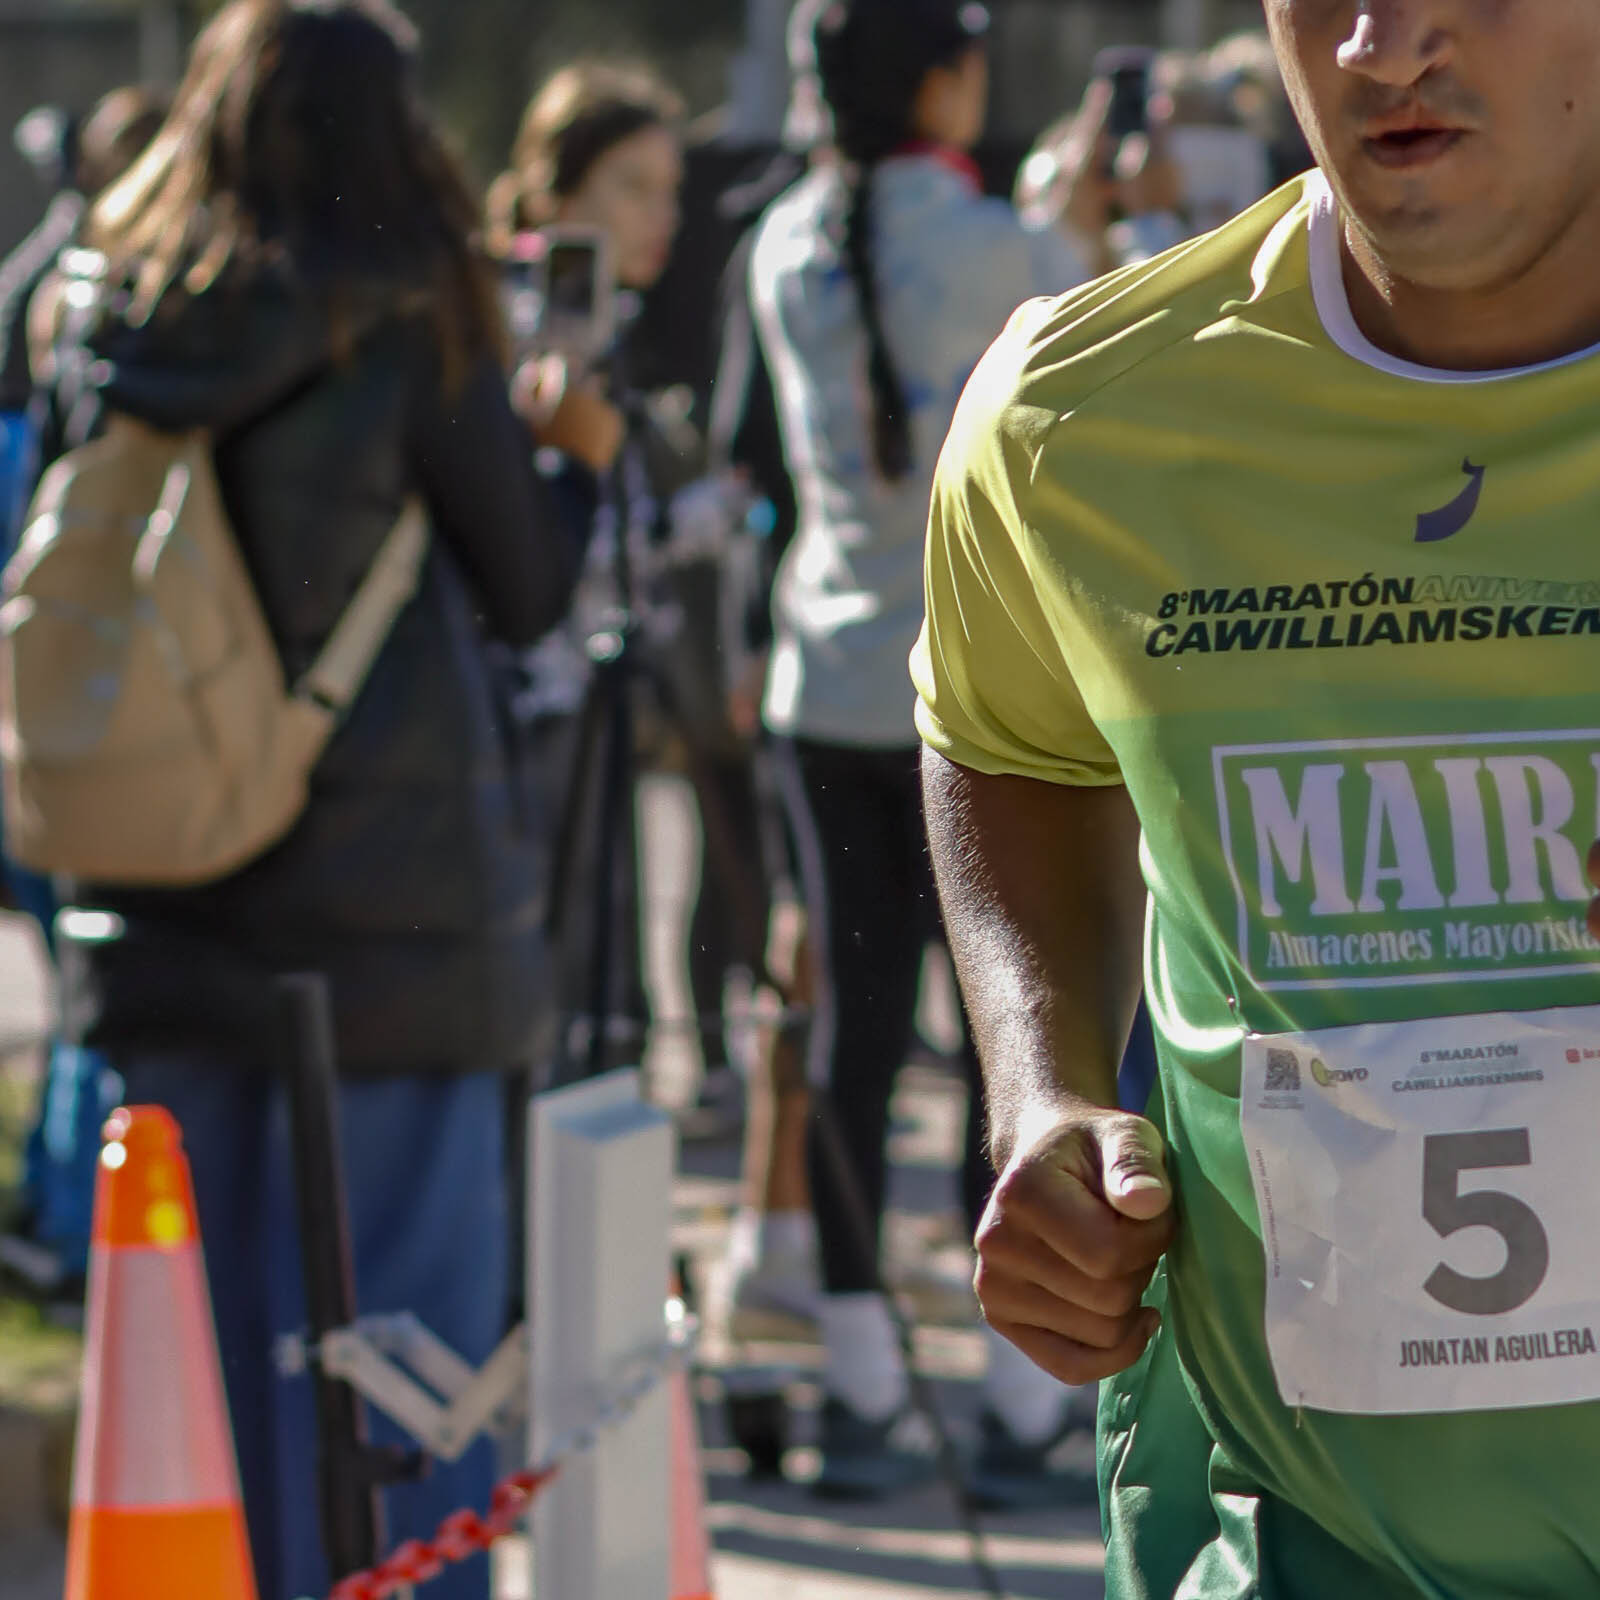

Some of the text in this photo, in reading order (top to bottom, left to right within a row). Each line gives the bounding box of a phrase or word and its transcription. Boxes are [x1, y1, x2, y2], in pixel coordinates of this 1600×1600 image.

[1266, 928, 1432, 968] Almacenes
[1422, 1127, 1549, 1316] 5
[1399, 1327, 1597, 1367] JONATAN AGUILERA
